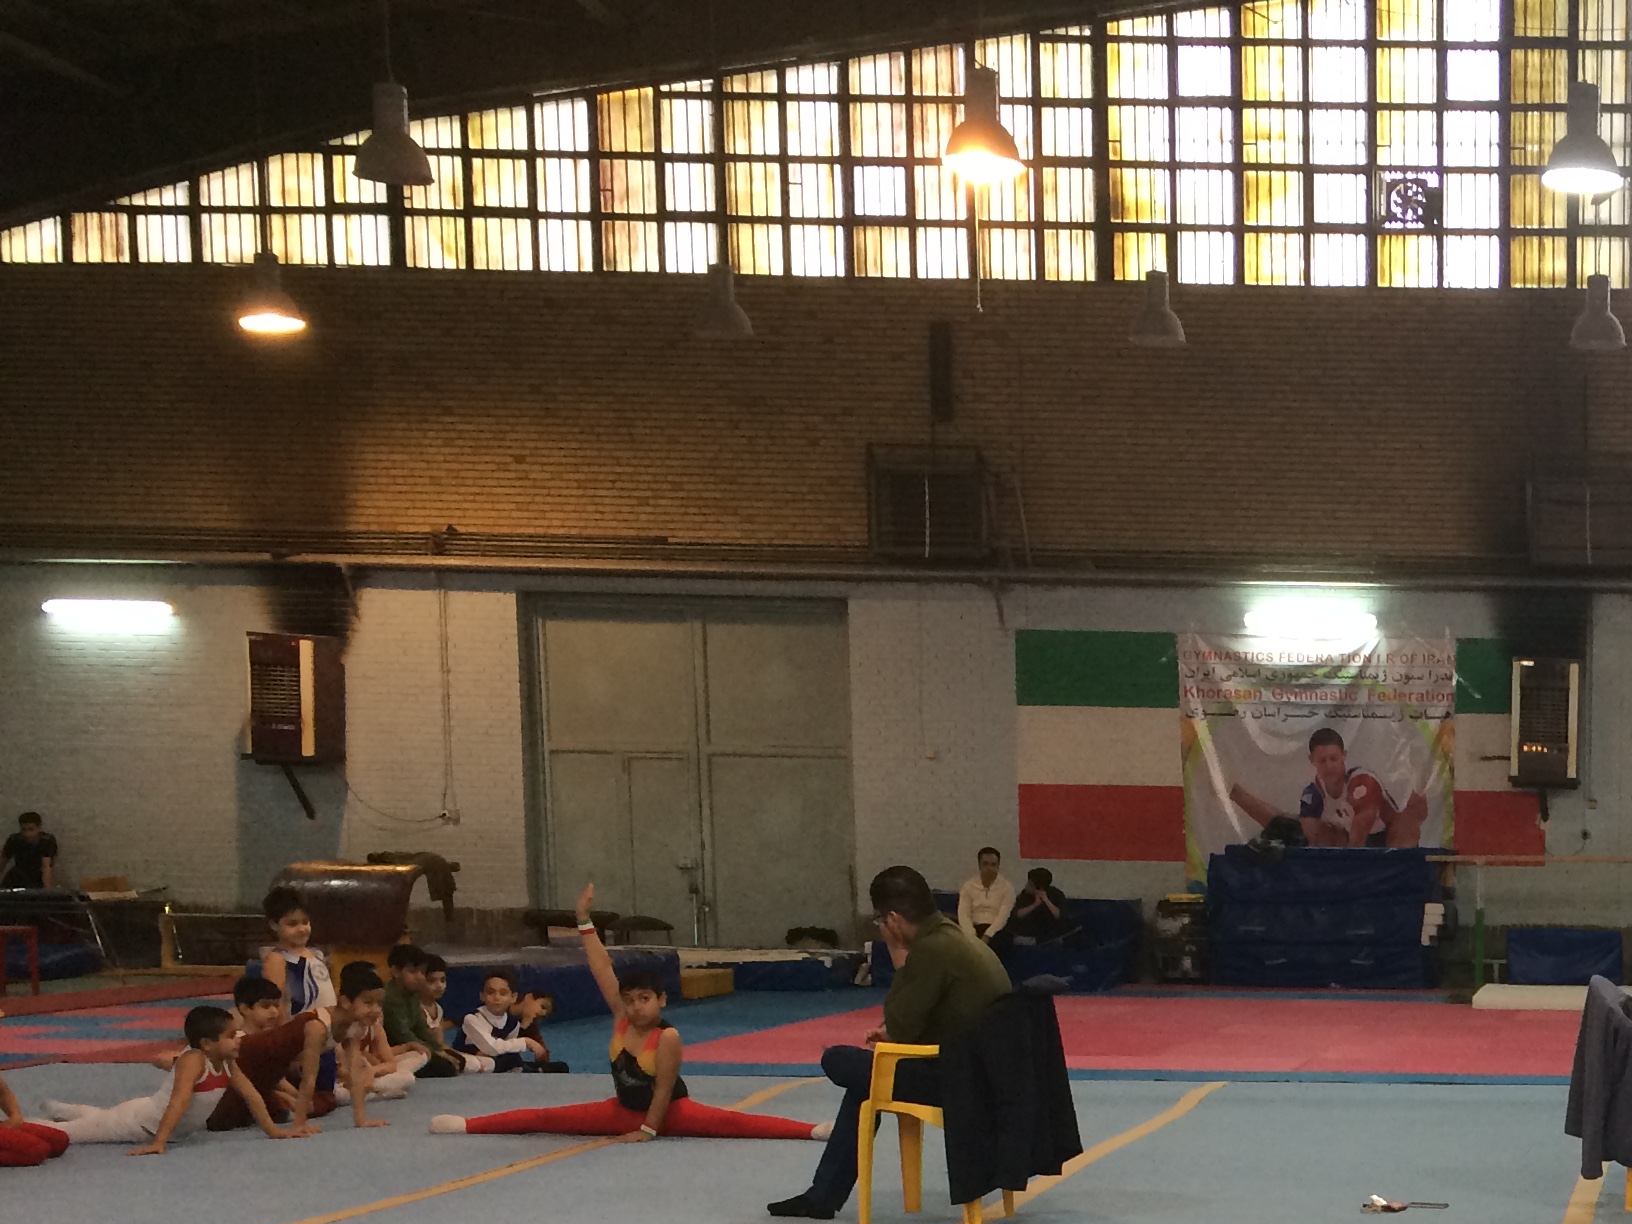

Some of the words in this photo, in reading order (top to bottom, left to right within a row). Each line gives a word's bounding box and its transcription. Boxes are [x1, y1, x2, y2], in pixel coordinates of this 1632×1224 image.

[1183, 651, 1274, 663] GYMNASTICS
[1399, 653, 1418, 665] OF
[1422, 653, 1456, 665] IRAN
[1183, 686, 1263, 699] Khorasan
[1271, 687, 1358, 702] Gymnastic
[1366, 688, 1455, 703] Federation
